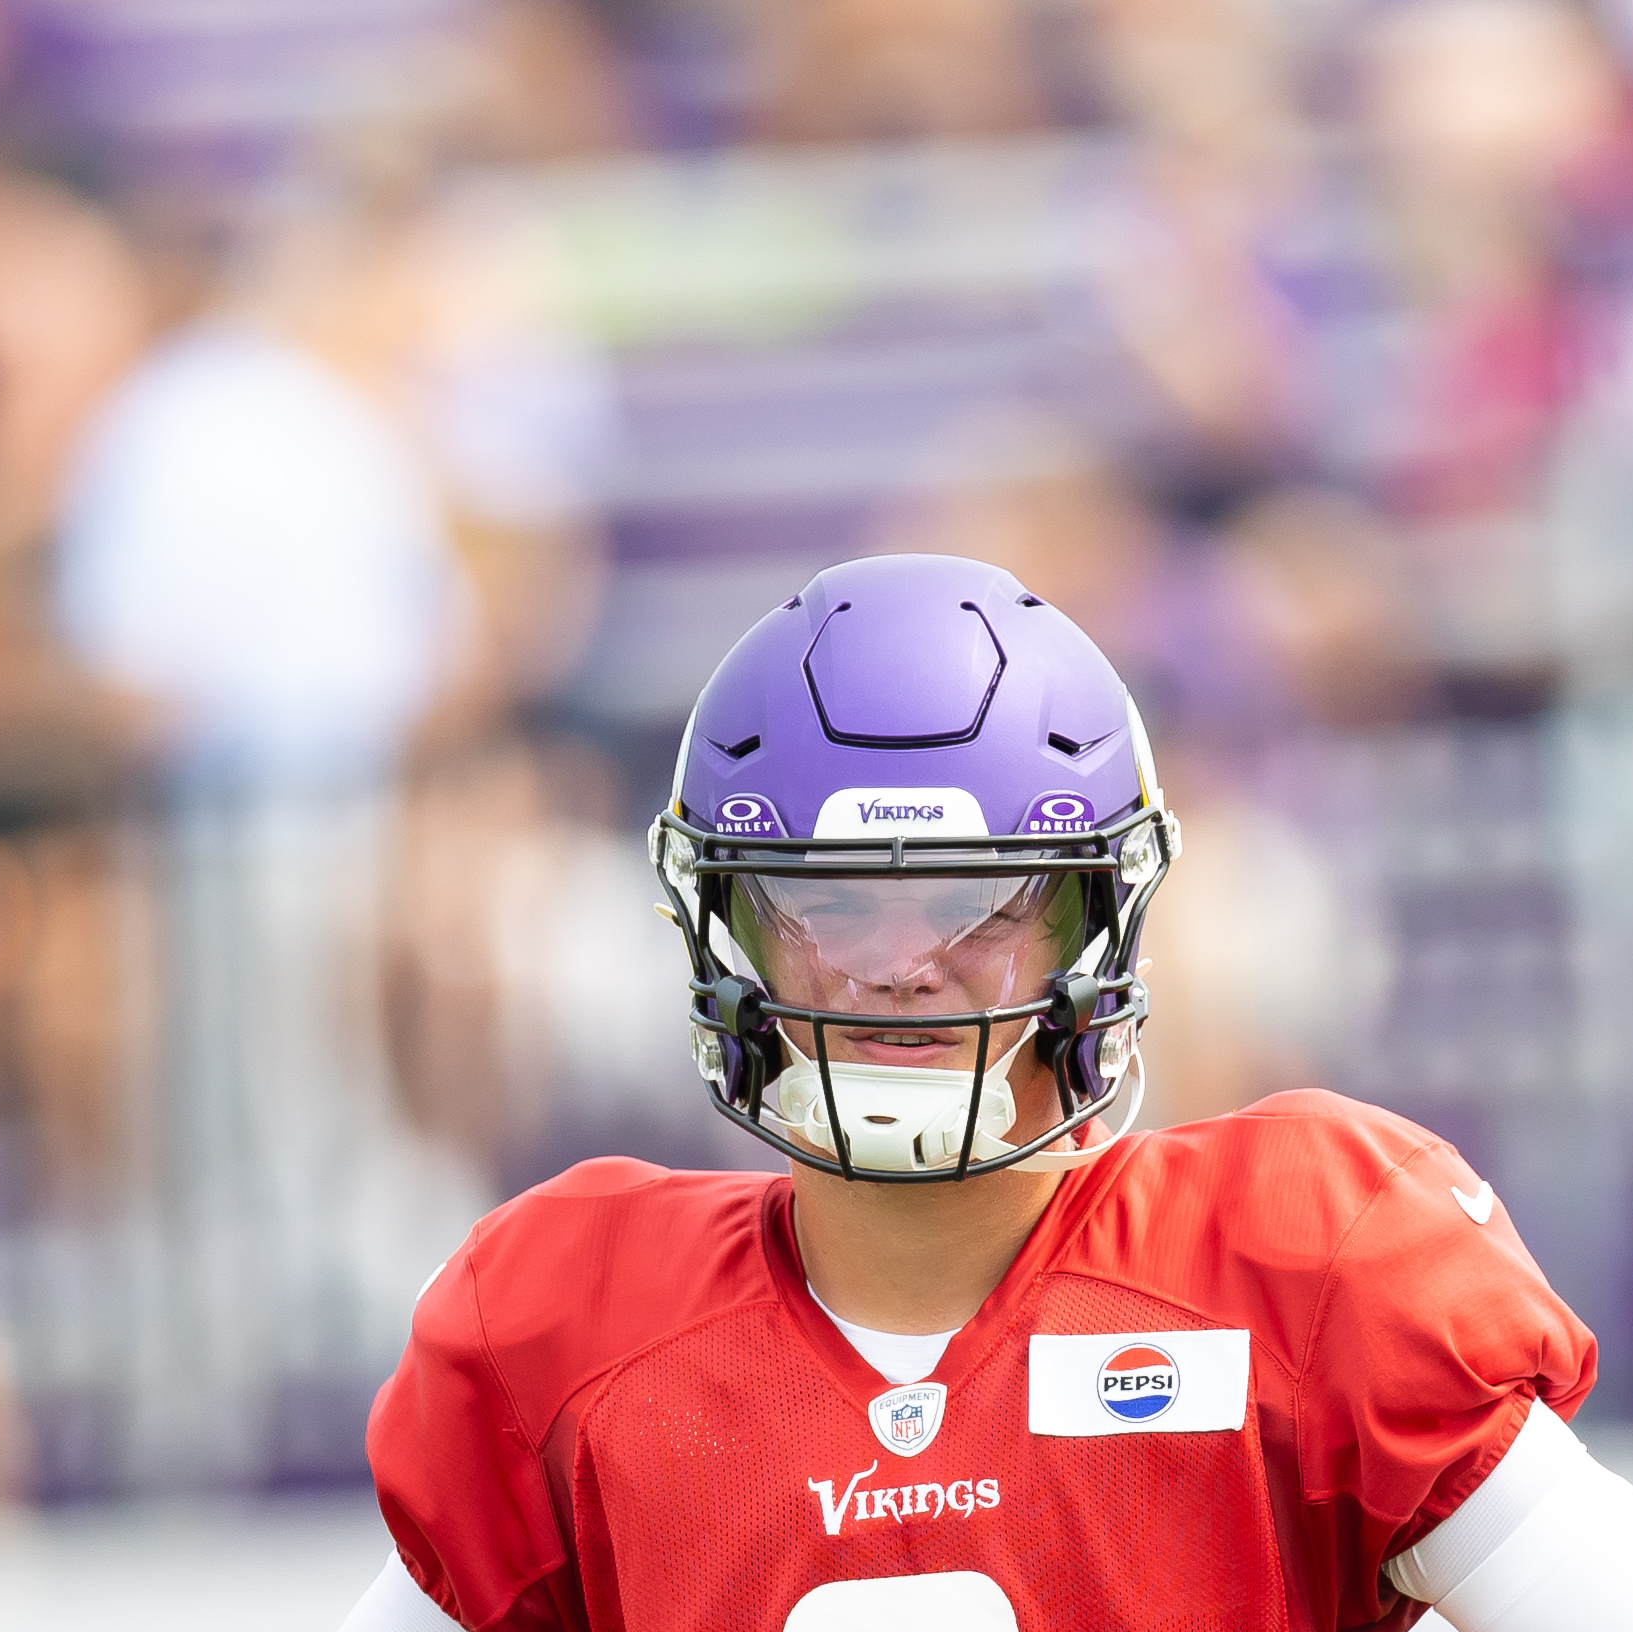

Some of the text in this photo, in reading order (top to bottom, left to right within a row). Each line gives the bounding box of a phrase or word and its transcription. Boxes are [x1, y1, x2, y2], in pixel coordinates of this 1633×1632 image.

[716, 821, 772, 833] OAKLEY
[1029, 820, 1091, 832] OAKLEY
[1104, 1374, 1173, 1392] PEPSI
[879, 1392, 936, 1410] EQUIPMENT
[895, 1419, 921, 1439] NFL
